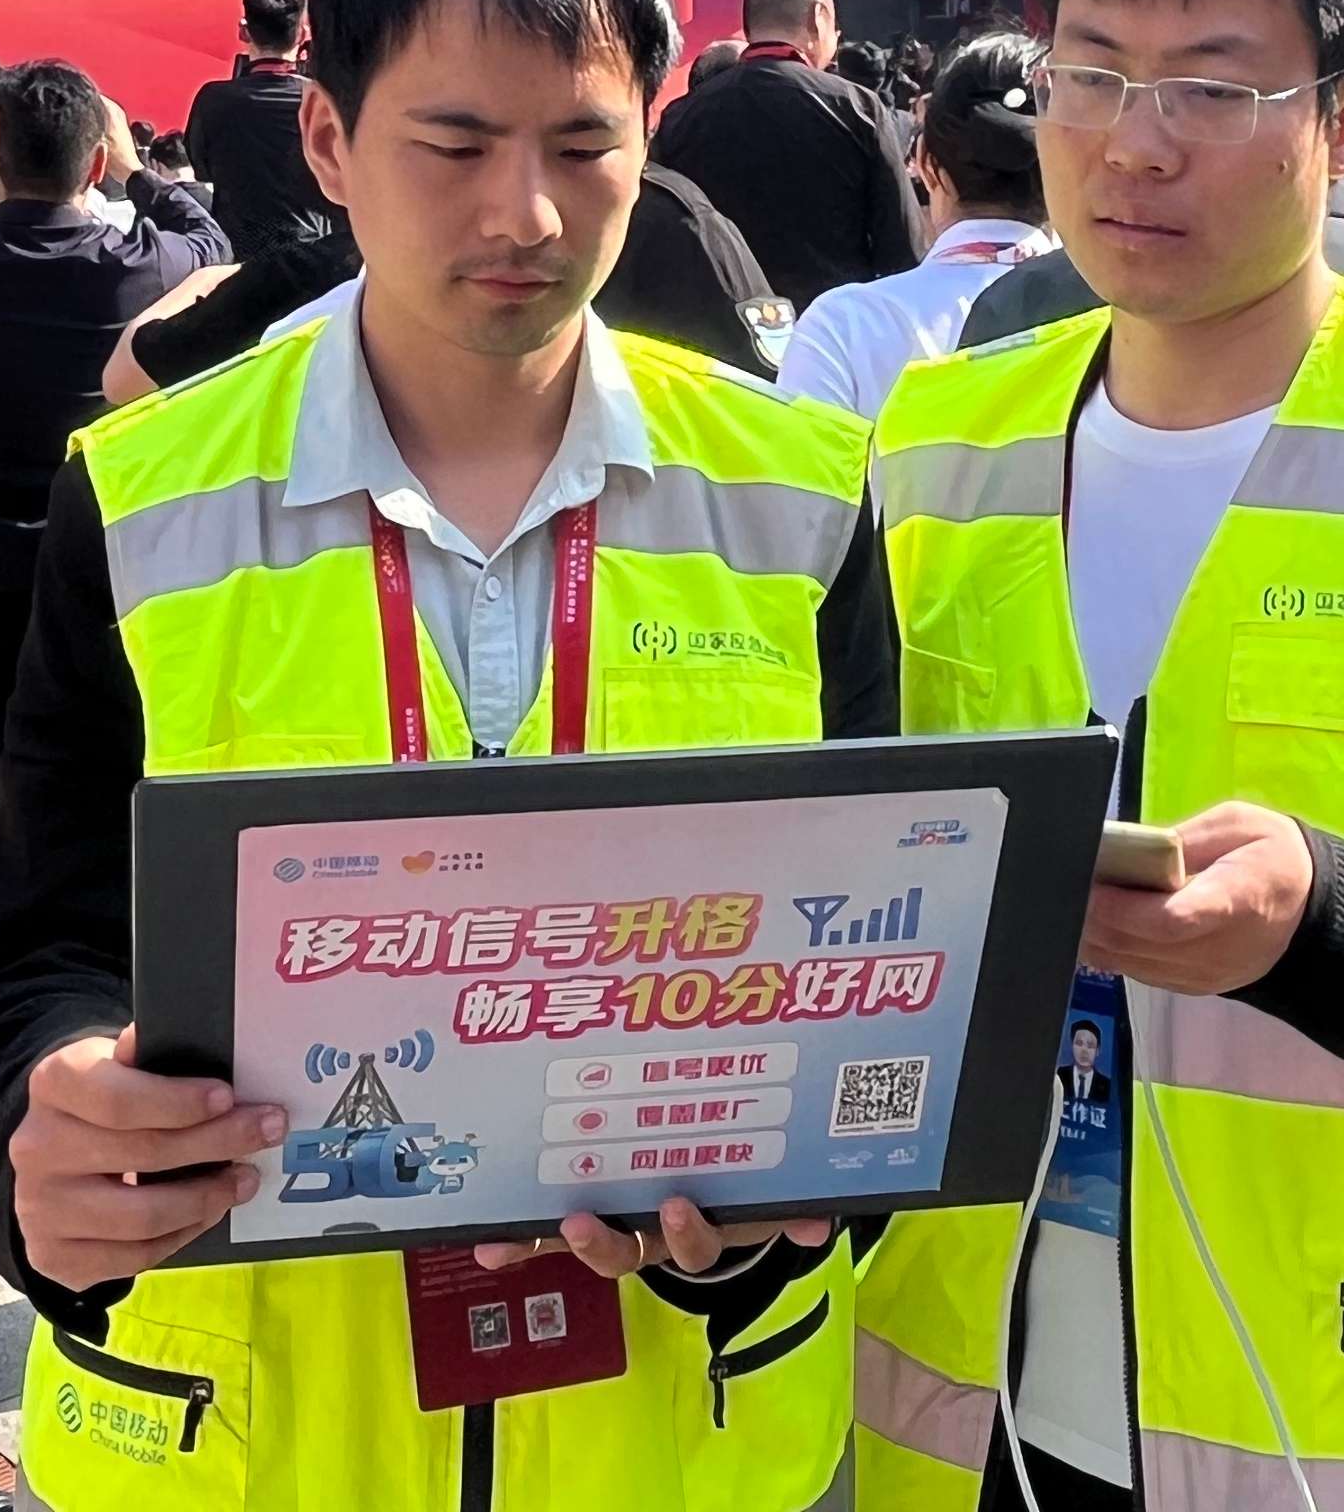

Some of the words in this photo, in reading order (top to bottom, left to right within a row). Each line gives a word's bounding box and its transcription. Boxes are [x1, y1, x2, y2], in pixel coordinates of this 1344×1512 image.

[281, 894, 759, 978] 移动信号升格
[457, 956, 937, 1040] 畅享10分好网
